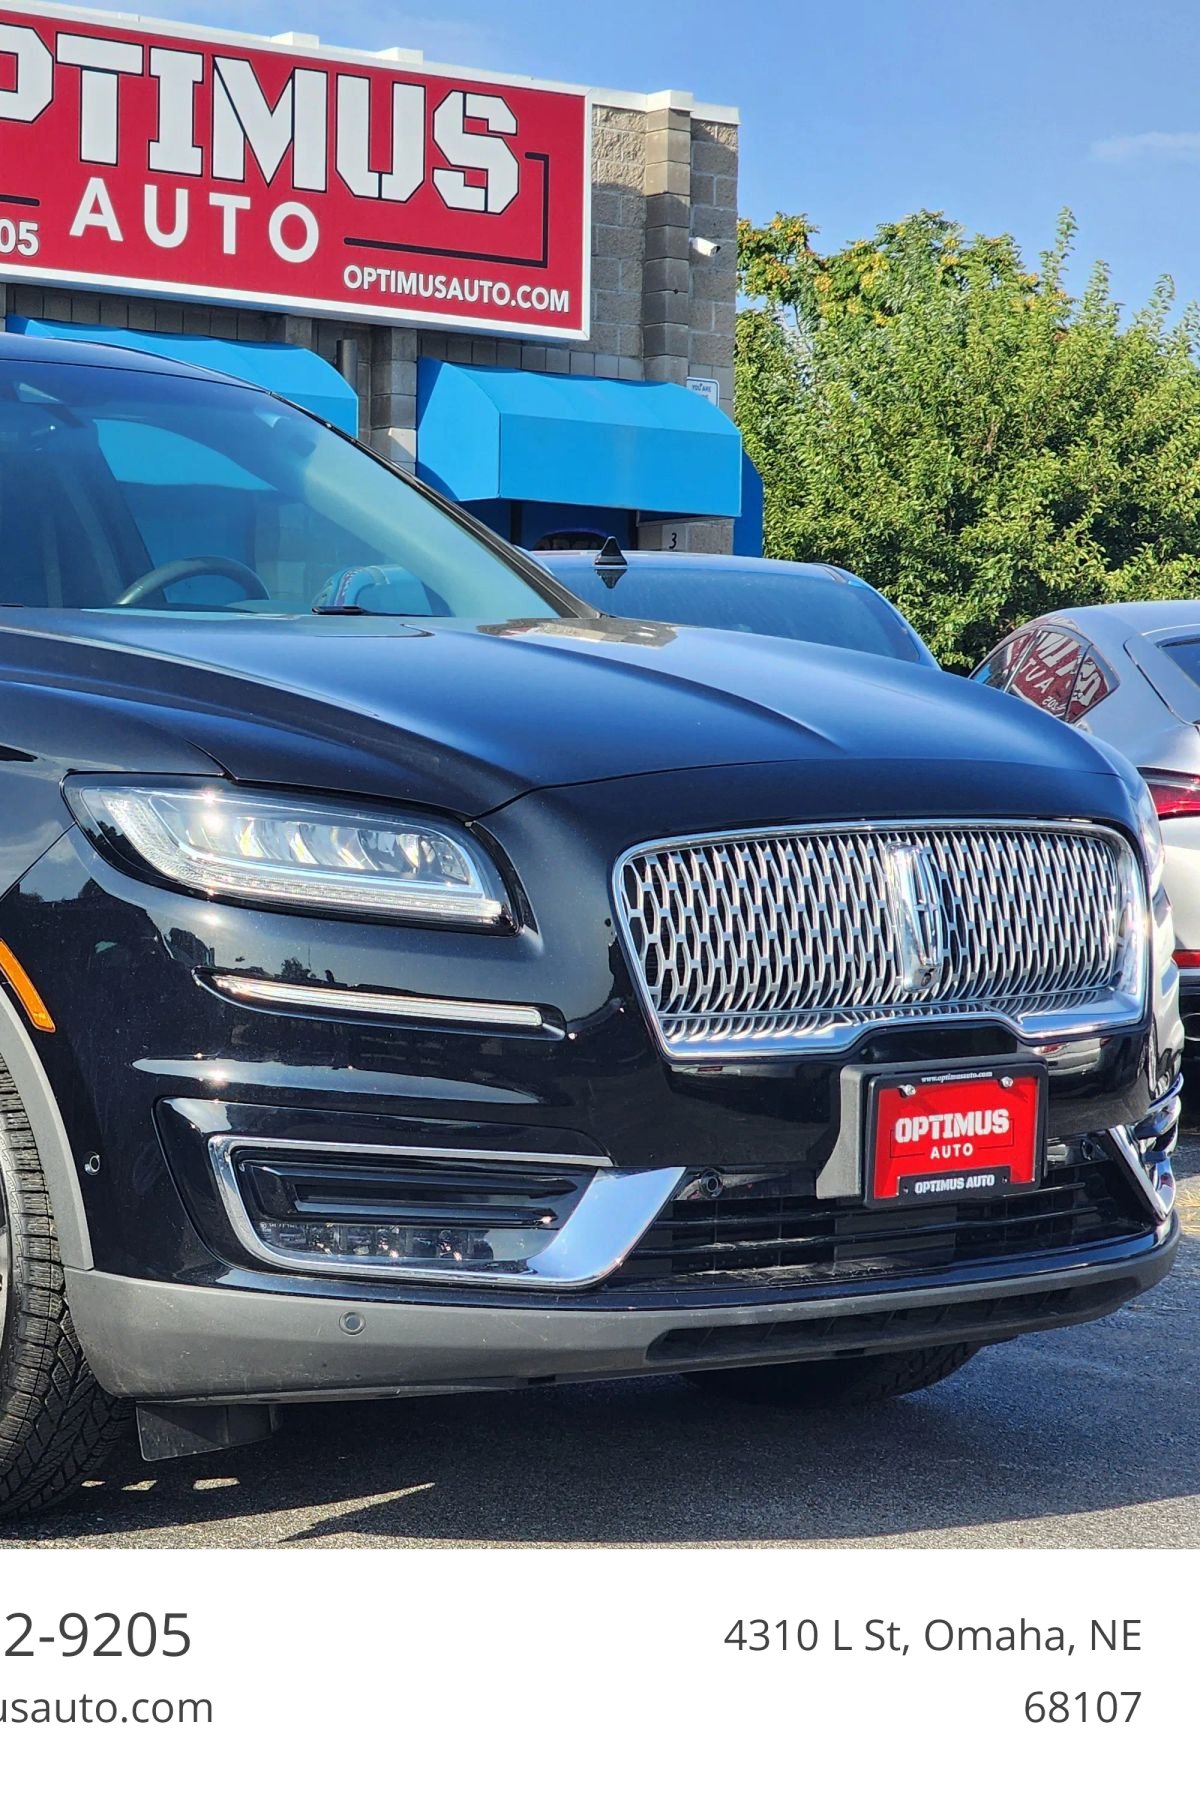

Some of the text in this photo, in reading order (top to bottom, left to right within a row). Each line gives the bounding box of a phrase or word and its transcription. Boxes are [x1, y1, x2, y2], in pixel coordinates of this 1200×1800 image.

[69, 177, 320, 264] AUTO
[343, 264, 570, 313] OPTIMUSAUTO.COM
[668, 532, 677, 549] 3
[921, 1071, 993, 1083] www.optimusauto.com
[895, 1108, 1009, 1143] OPTIMUS
[930, 1143, 973, 1160] AUTO
[915, 1174, 995, 1194] OPTIMUS AUTO
